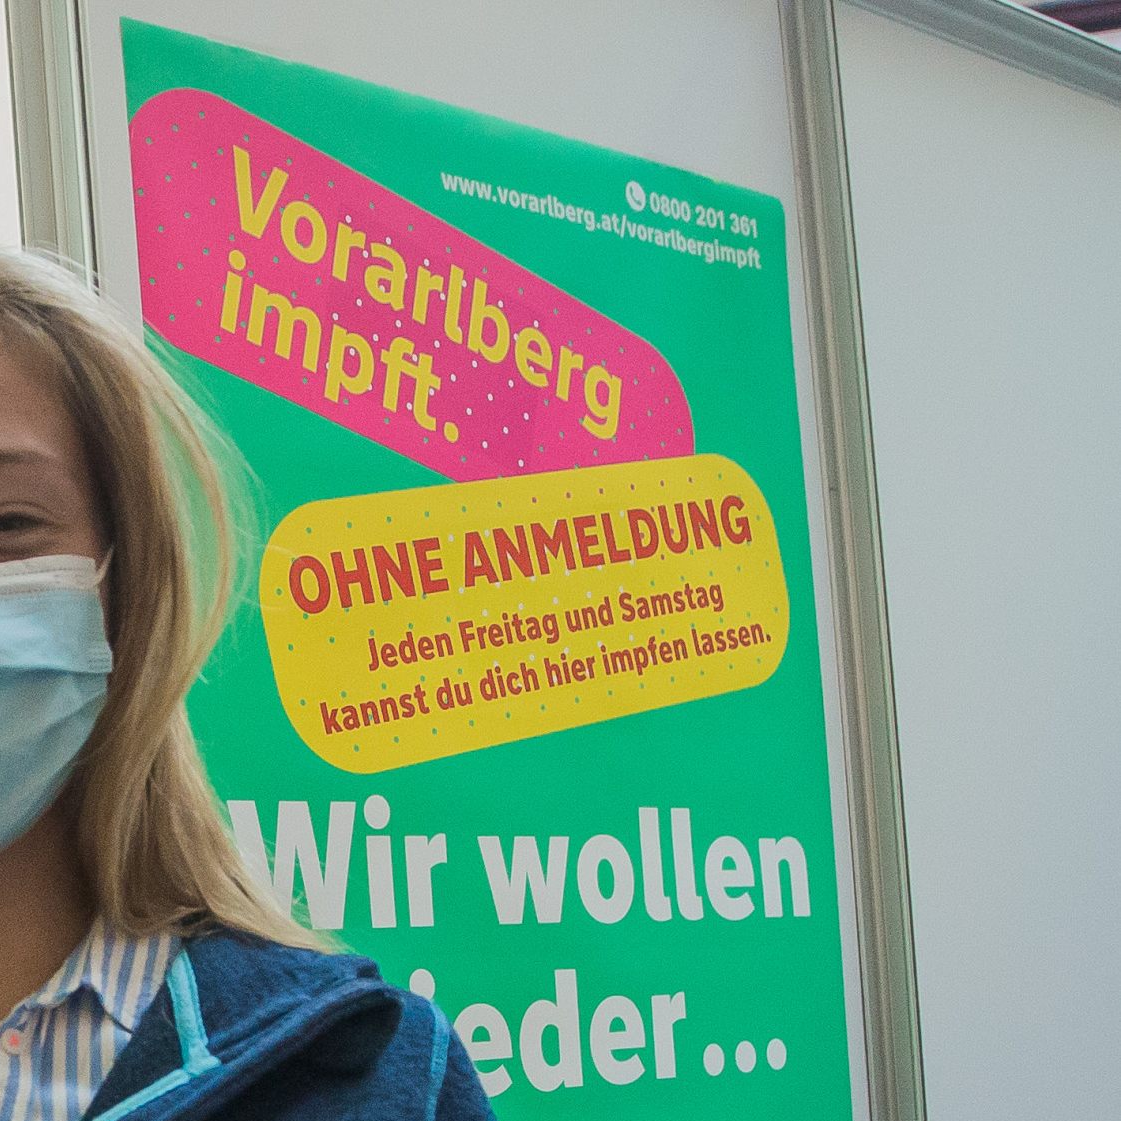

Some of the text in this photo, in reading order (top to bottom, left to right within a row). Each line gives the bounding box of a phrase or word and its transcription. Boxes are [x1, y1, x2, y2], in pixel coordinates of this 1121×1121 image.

[440, 172, 761, 269] www.vorarlberg.at/vorarlbergimpft
[649, 192, 758, 238] 0800 201 361
[219, 249, 459, 443] impft.
[232, 144, 623, 440] Vorarlberg
[288, 494, 753, 615] OHNE ANMELDUNG
[320, 621, 772, 735] kannst du dich hier impfen lassen.
[368, 583, 725, 671] Jeden Freitag und Samstag
[227, 794, 811, 929] Wir wollen
